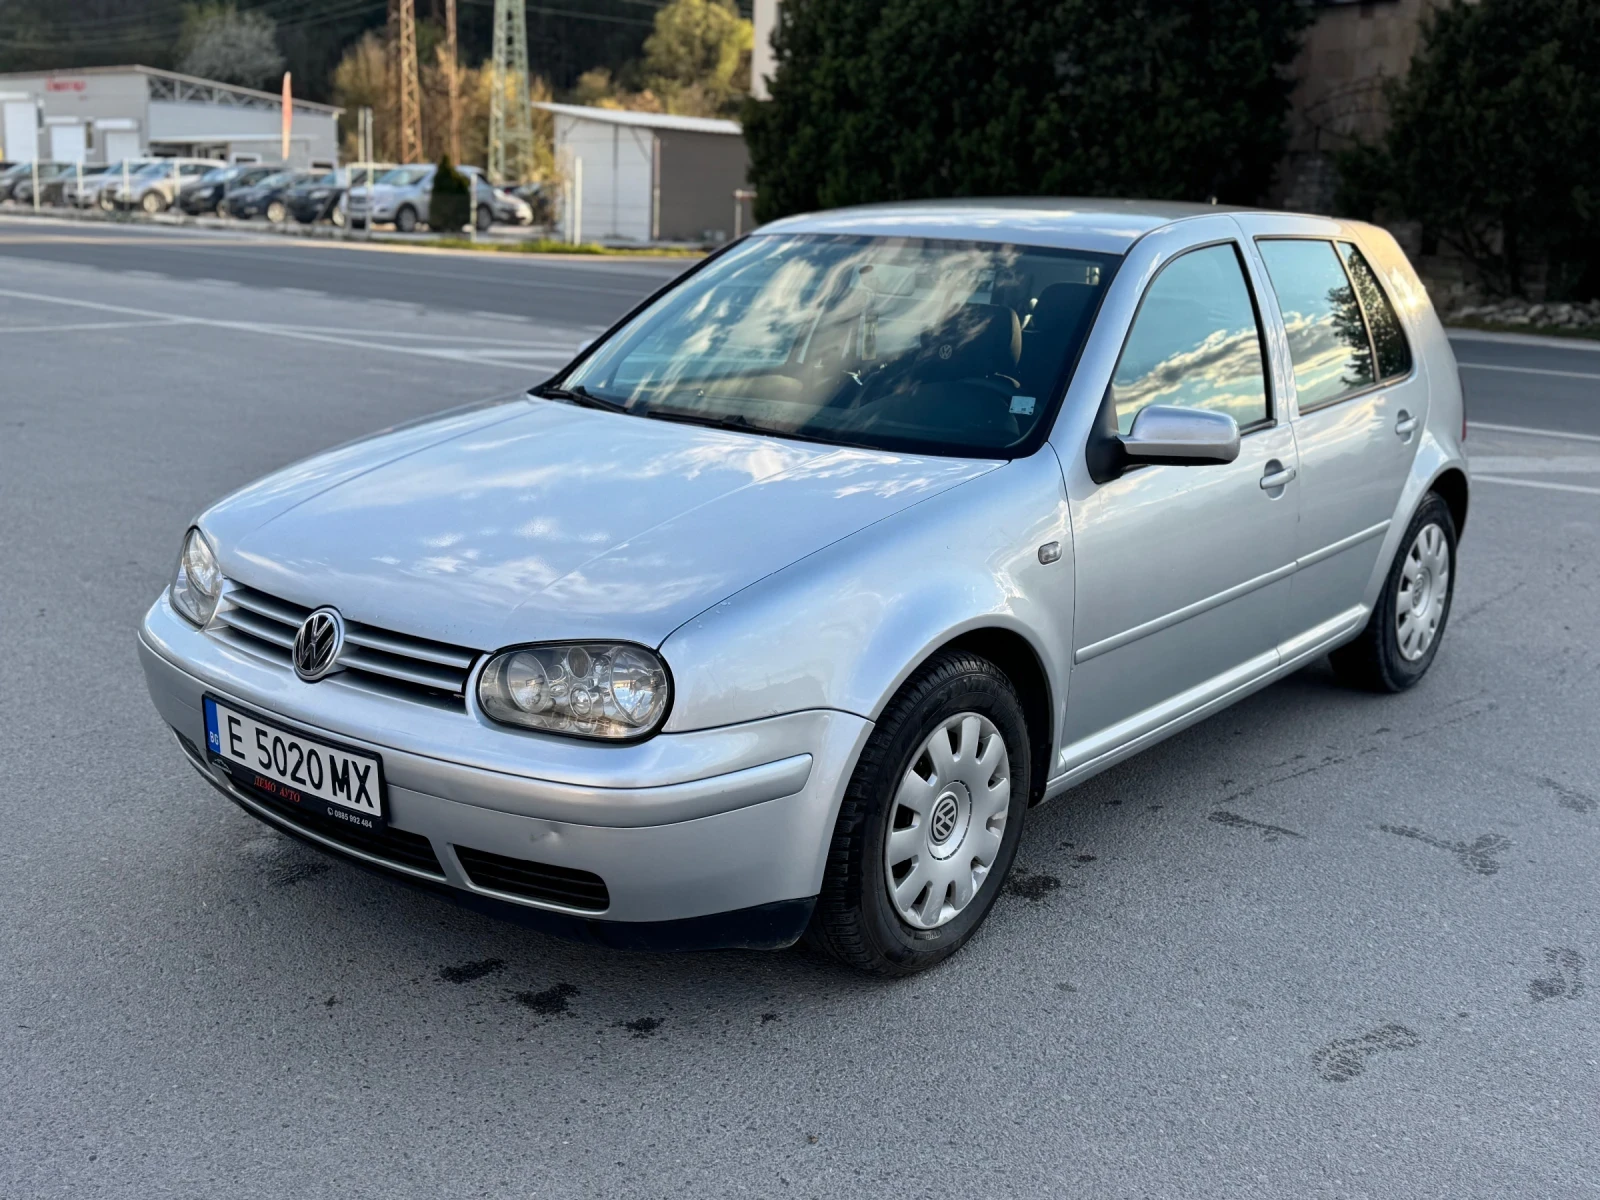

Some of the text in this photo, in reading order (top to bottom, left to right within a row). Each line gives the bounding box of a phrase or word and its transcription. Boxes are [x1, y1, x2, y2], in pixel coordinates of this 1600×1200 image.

[209, 731, 219, 746] BG
[227, 715, 374, 808] E 5020 MX
